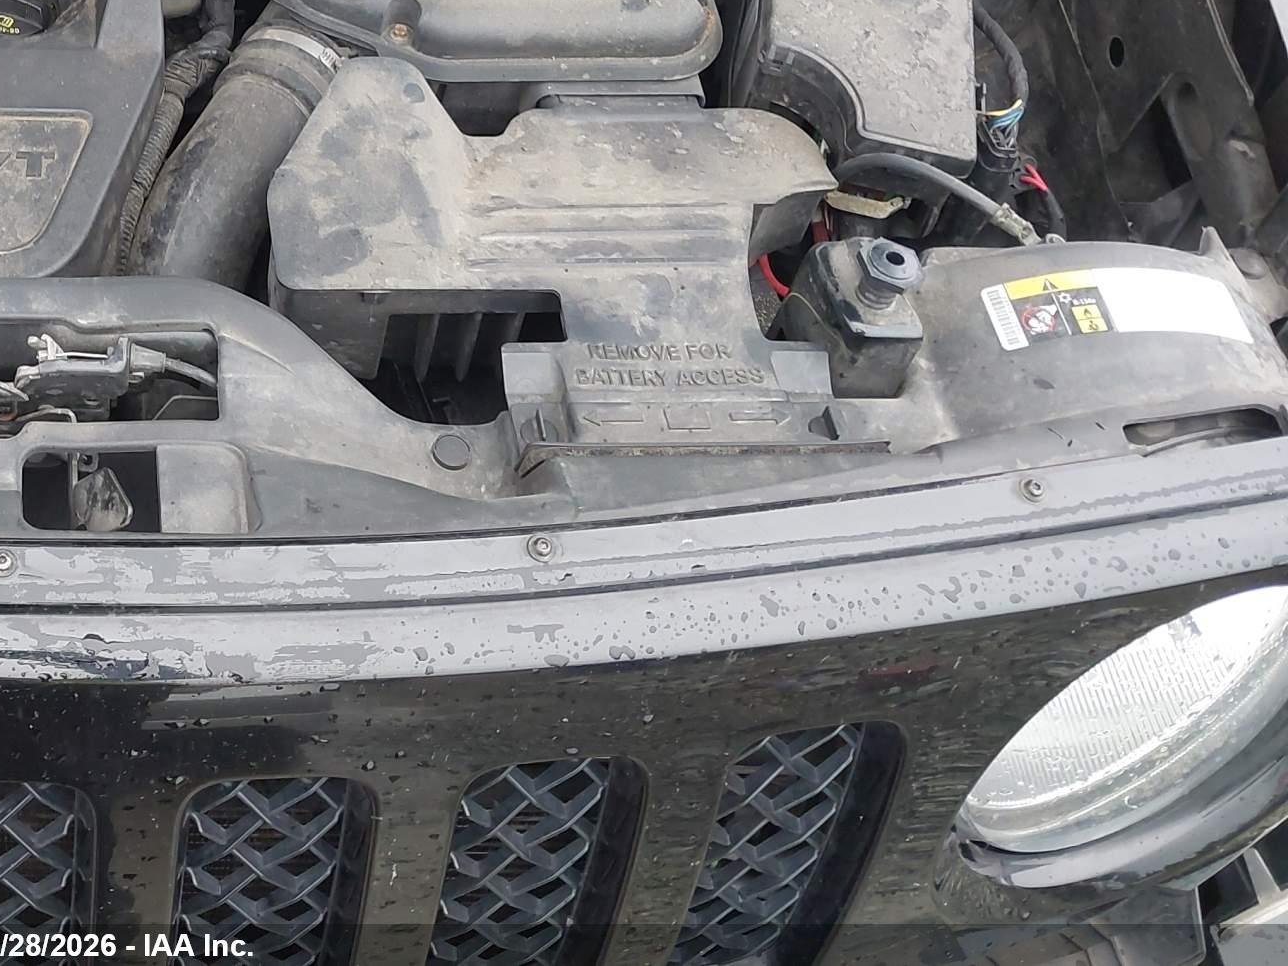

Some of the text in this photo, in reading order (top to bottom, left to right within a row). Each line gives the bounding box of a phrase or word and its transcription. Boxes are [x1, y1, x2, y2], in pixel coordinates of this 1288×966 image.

[586, 343, 732, 362] REMOVE FOR
[575, 366, 764, 387] BATTERY ACCESS
